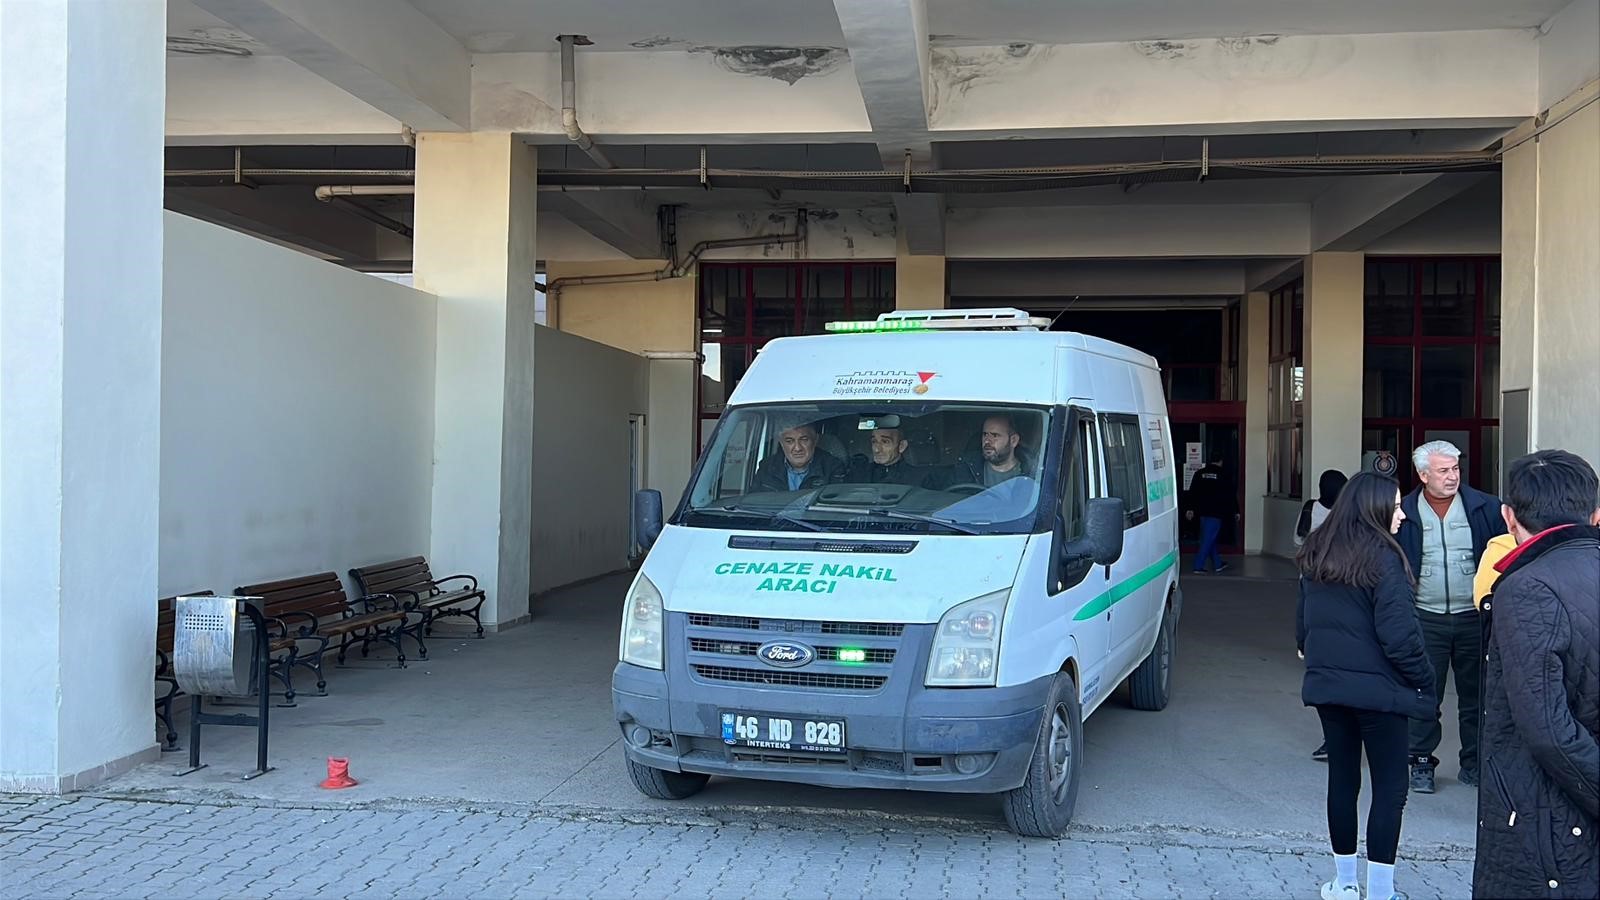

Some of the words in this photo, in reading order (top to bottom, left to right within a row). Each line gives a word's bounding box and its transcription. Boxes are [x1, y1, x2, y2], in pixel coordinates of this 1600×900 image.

[836, 377, 913, 386] Kahramanmaraş
[833, 387, 872, 395] Büyükşehir
[873, 386, 911, 395] Belediyesi
[714, 562, 814, 575] CENAZE
[756, 577, 837, 594] ARACI
[768, 646, 798, 660] Ford
[735, 715, 758, 739] 46
[768, 718, 792, 742] ND
[805, 721, 841, 745] 828
[746, 739, 791, 750] INTERTEKS
